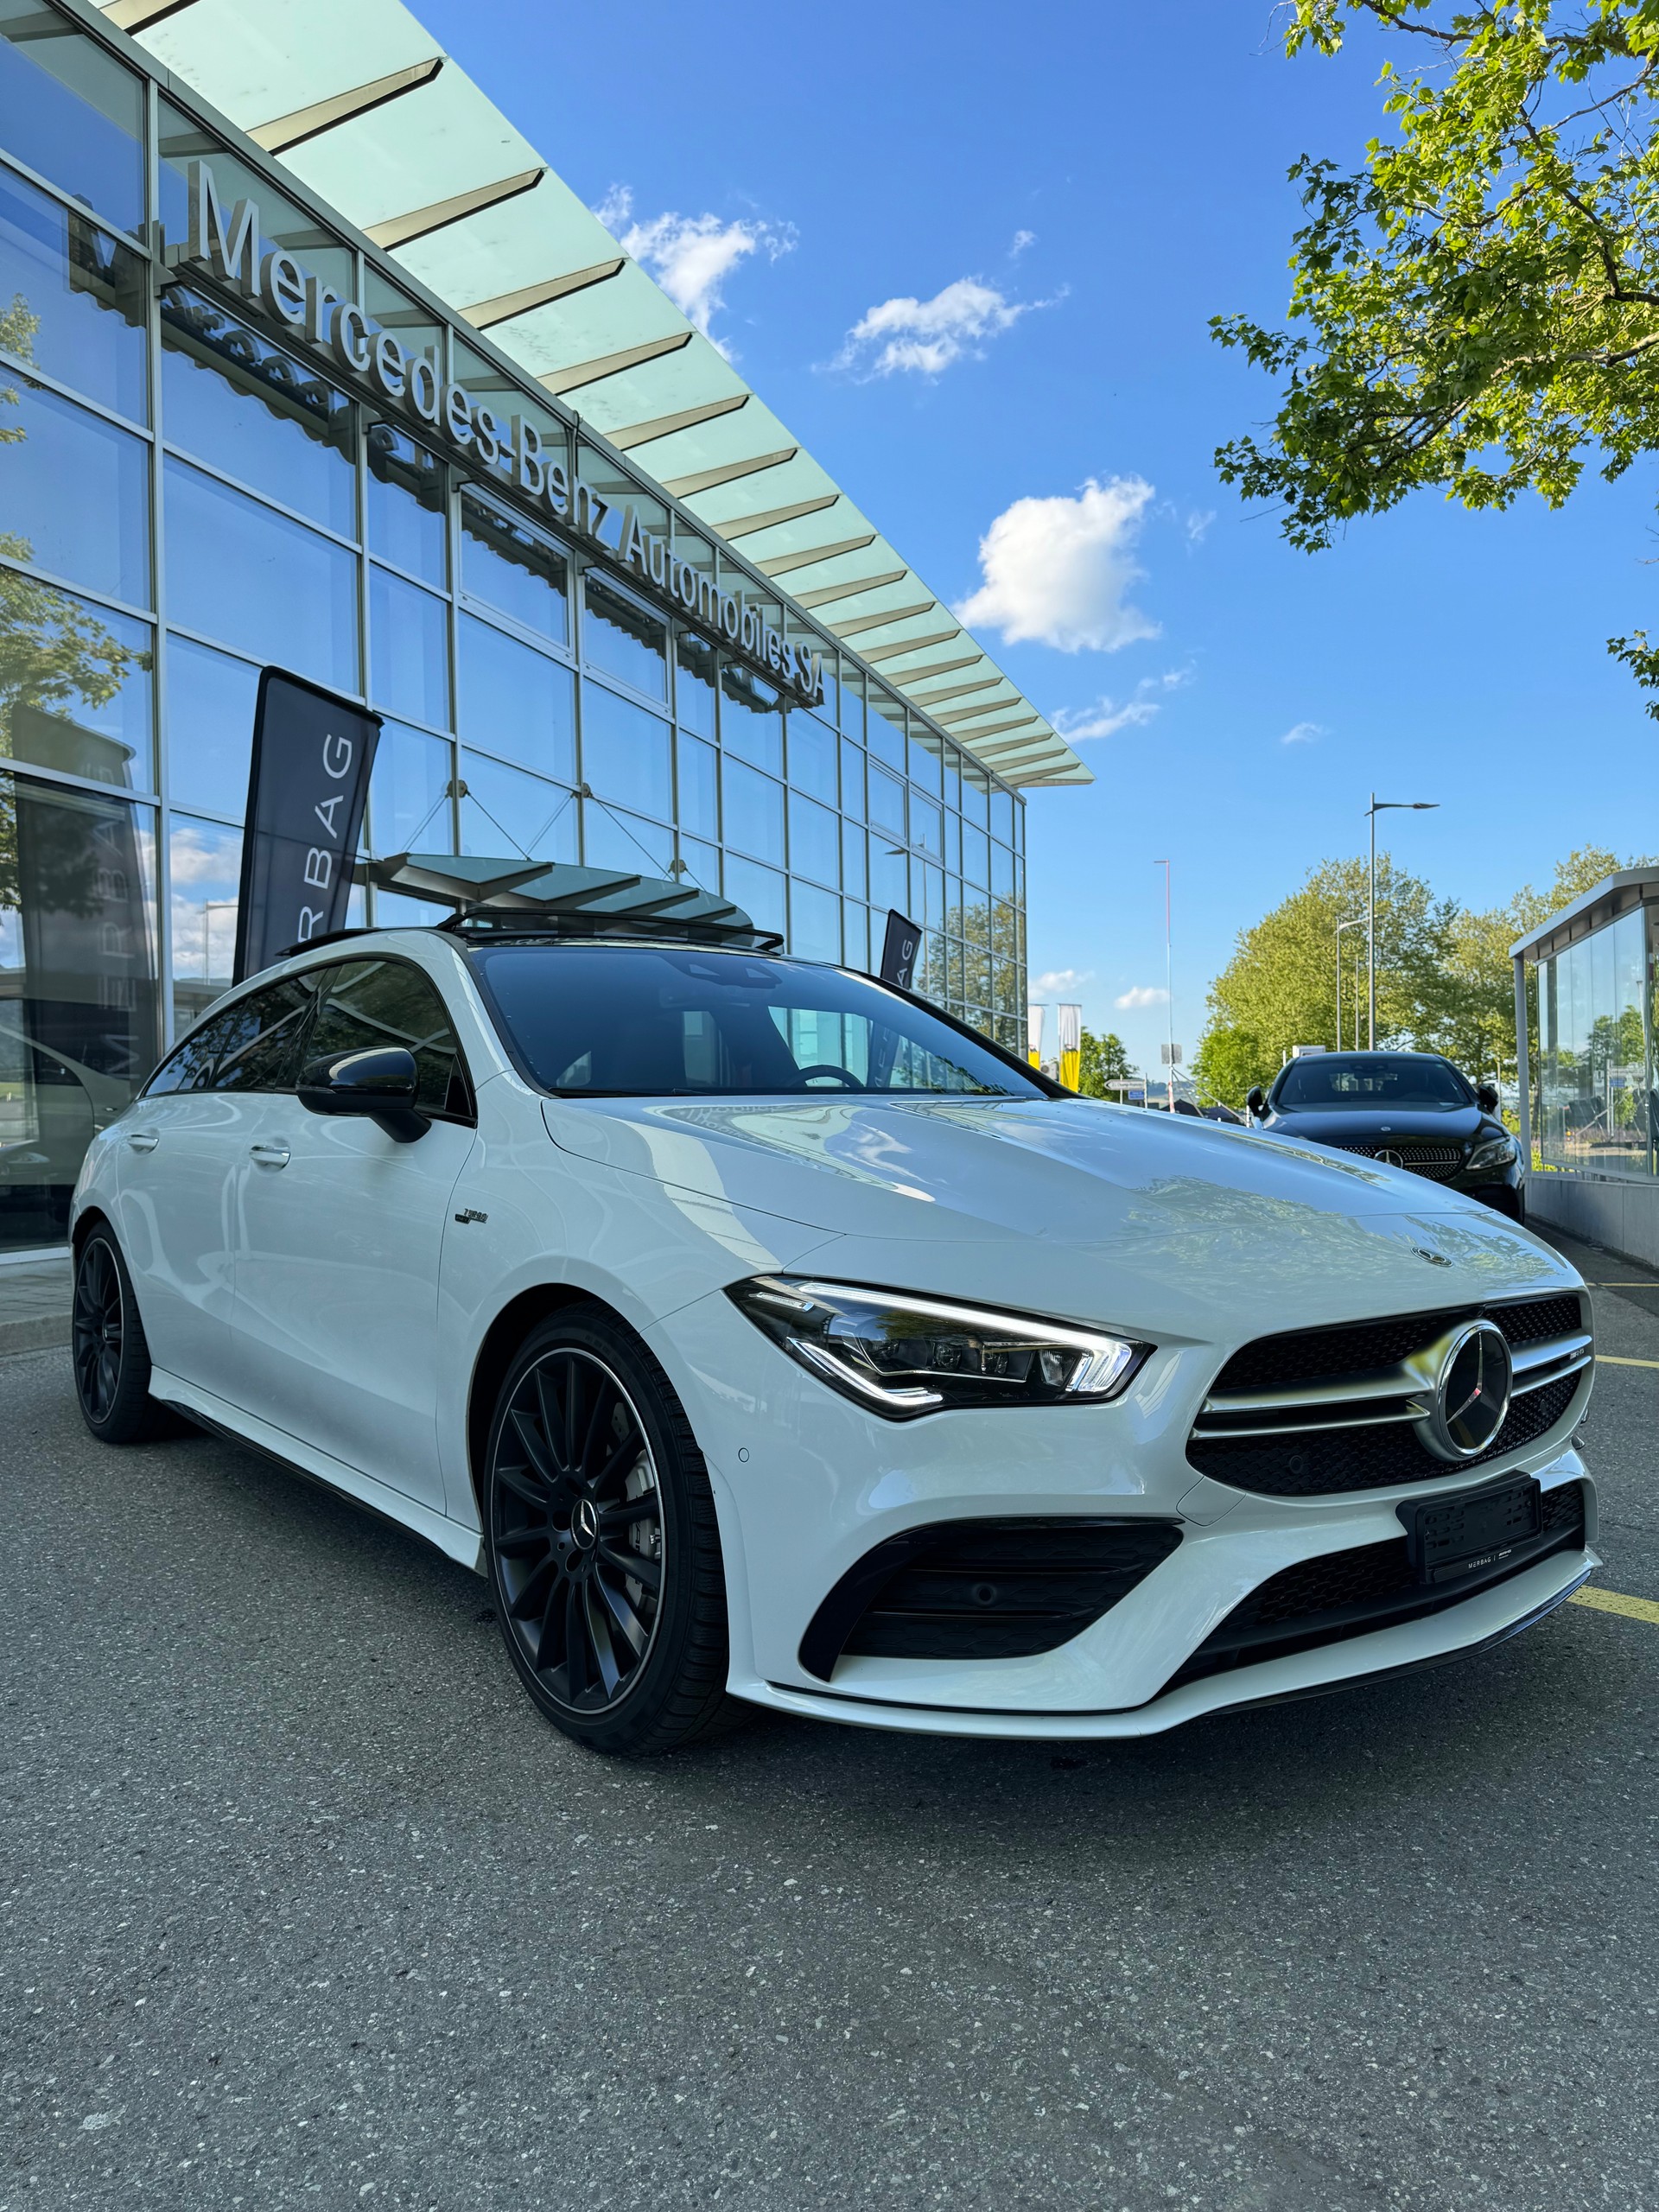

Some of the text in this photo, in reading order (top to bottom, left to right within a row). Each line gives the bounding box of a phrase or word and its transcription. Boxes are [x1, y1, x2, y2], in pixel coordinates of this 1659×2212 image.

[188, 160, 825, 705] Mercedes-Benz Automobiles SA
[1468, 1556, 1491, 1569] MERBAG
